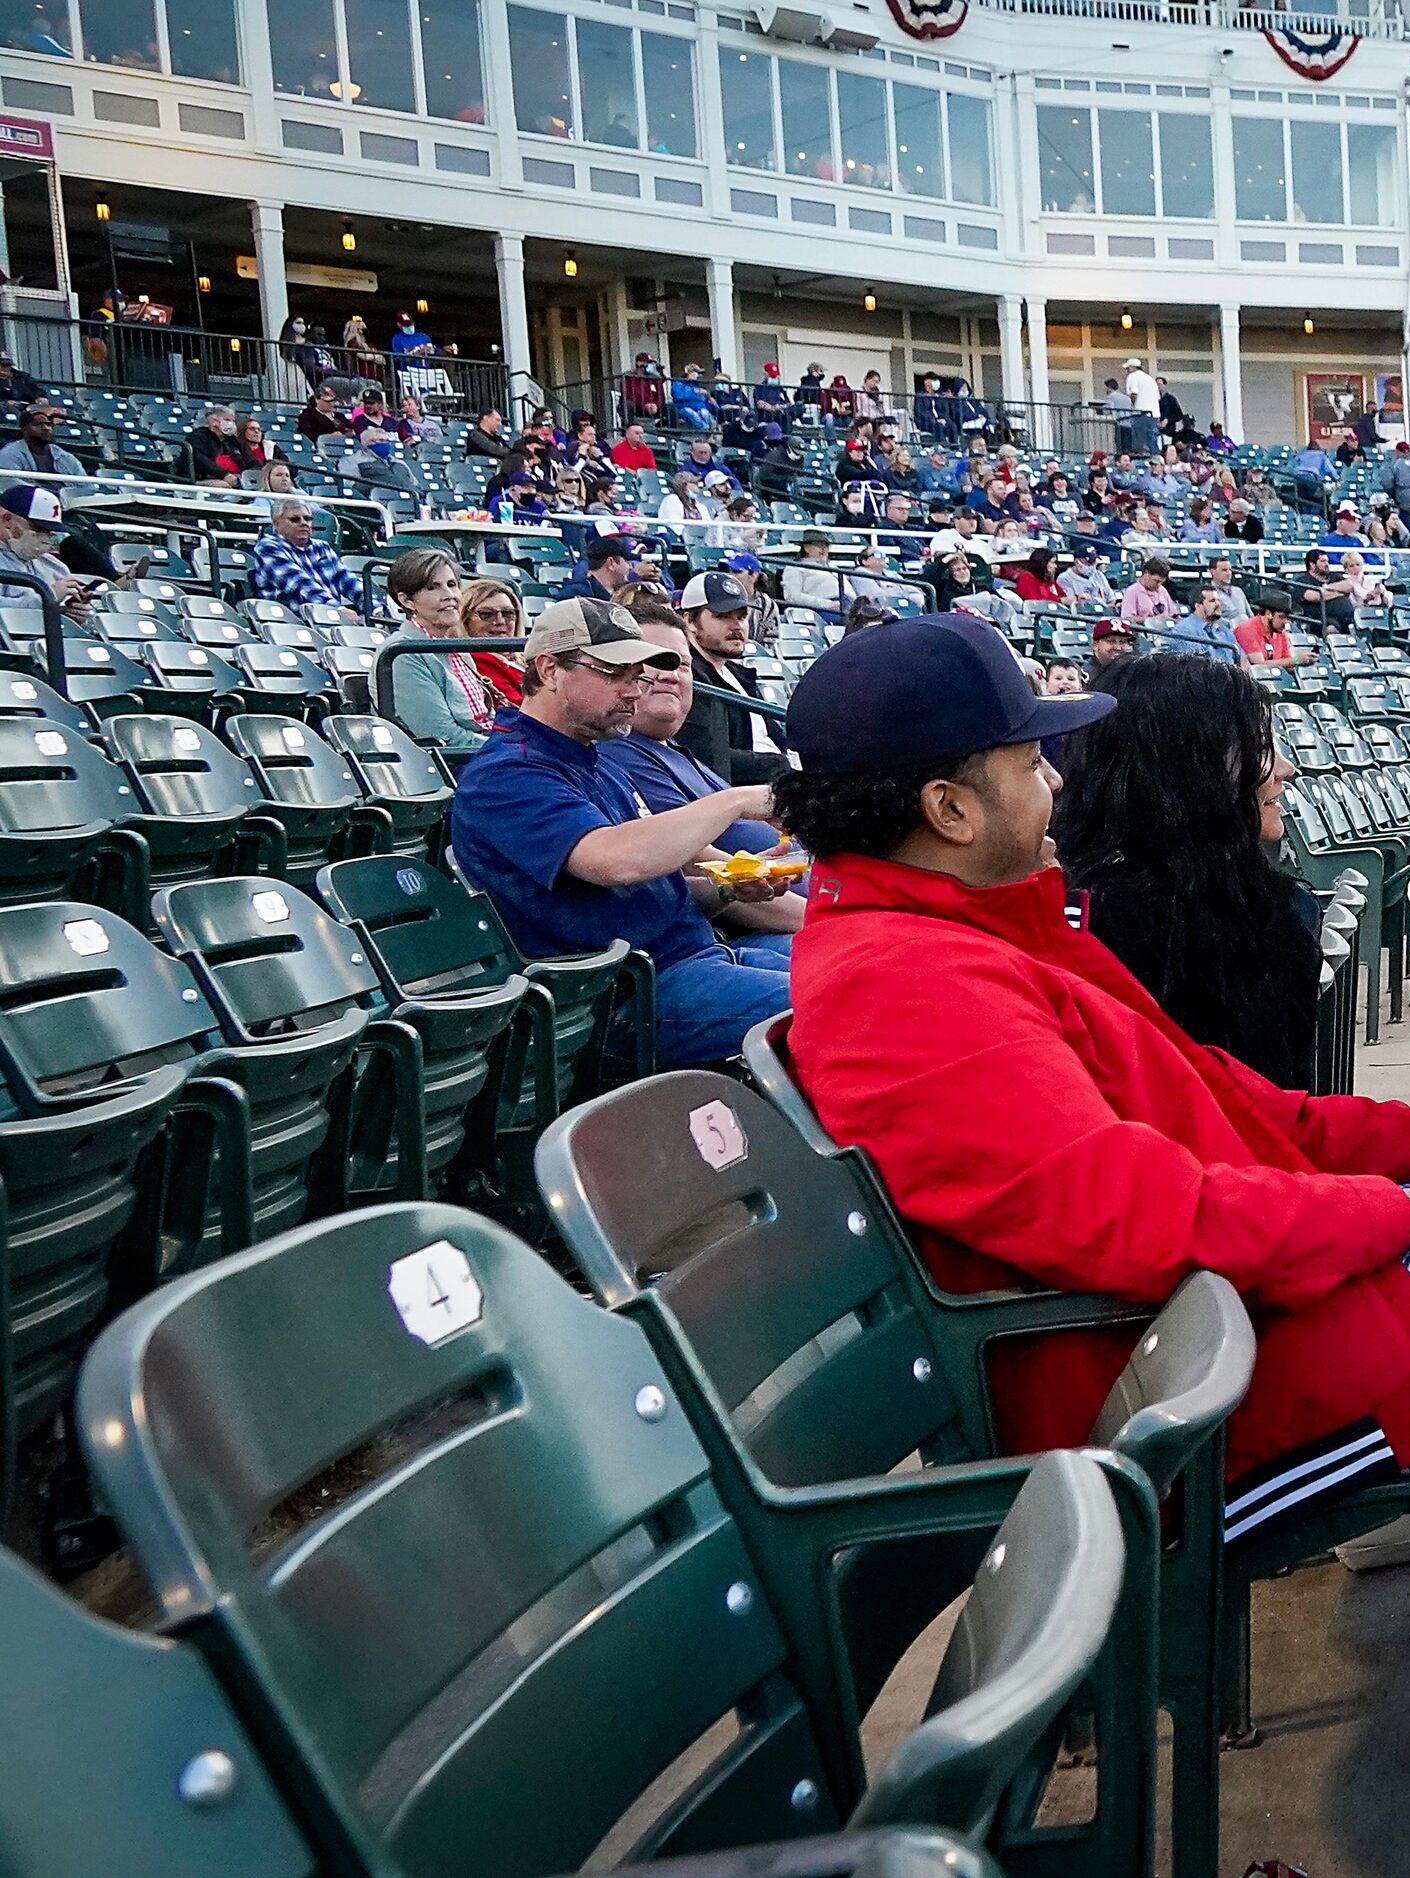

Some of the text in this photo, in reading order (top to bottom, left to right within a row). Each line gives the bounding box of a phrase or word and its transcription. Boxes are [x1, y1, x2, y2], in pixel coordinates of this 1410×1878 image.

[402, 873, 421, 892] 10
[706, 1113, 726, 1154] 5
[427, 1264, 451, 1314] 4
